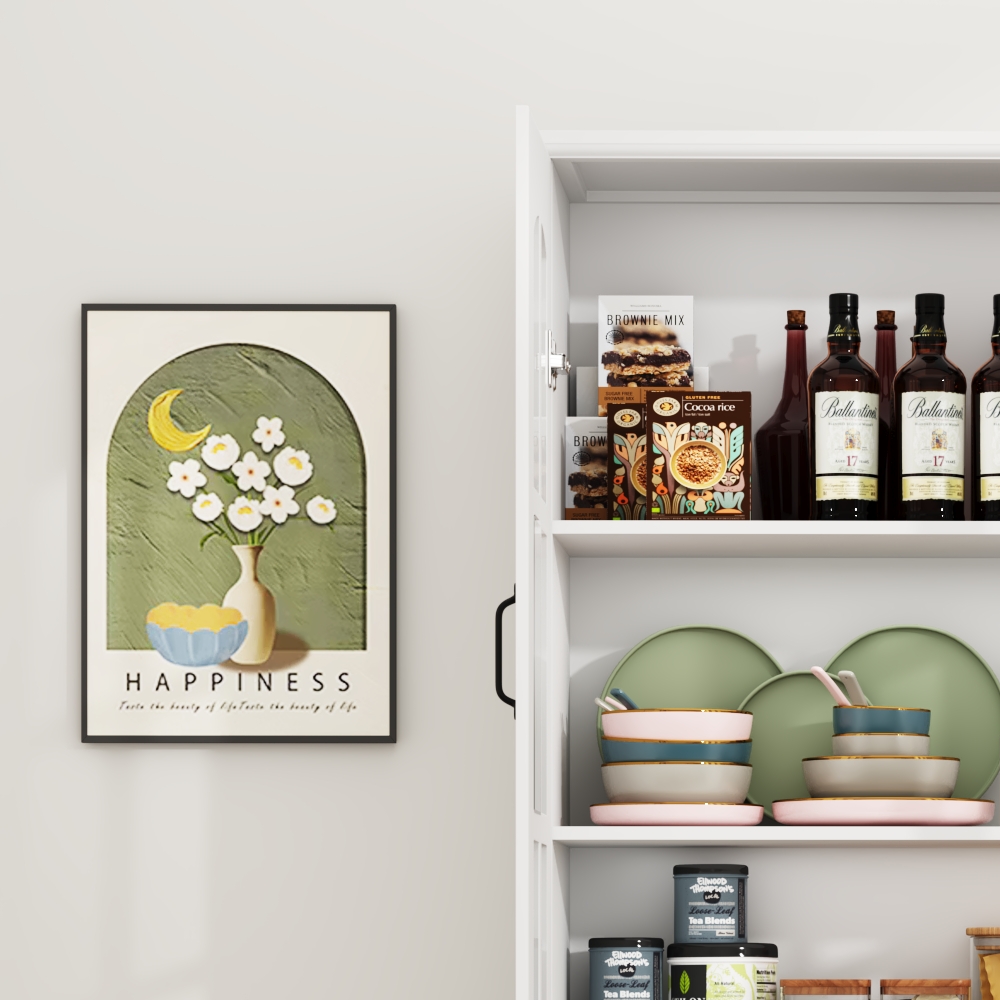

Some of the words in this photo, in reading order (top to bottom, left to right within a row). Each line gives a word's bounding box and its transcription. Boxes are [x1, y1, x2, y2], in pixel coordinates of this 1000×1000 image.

[606, 314, 659, 326] BROWNIE
[664, 314, 685, 326] MIX
[684, 402, 715, 412] Cocoa
[717, 402, 736, 412] rice
[846, 455, 858, 467] 17
[933, 455, 945, 467] 17
[126, 672, 350, 692] HAPPINESS
[688, 906, 735, 917] Loose-Leaf
[688, 917, 703, 925] Tea
[704, 917, 735, 925] Blends
[603, 980, 650, 990] Loose-Leaf
[603, 990, 618, 998] Tea
[620, 990, 650, 998] Blends
